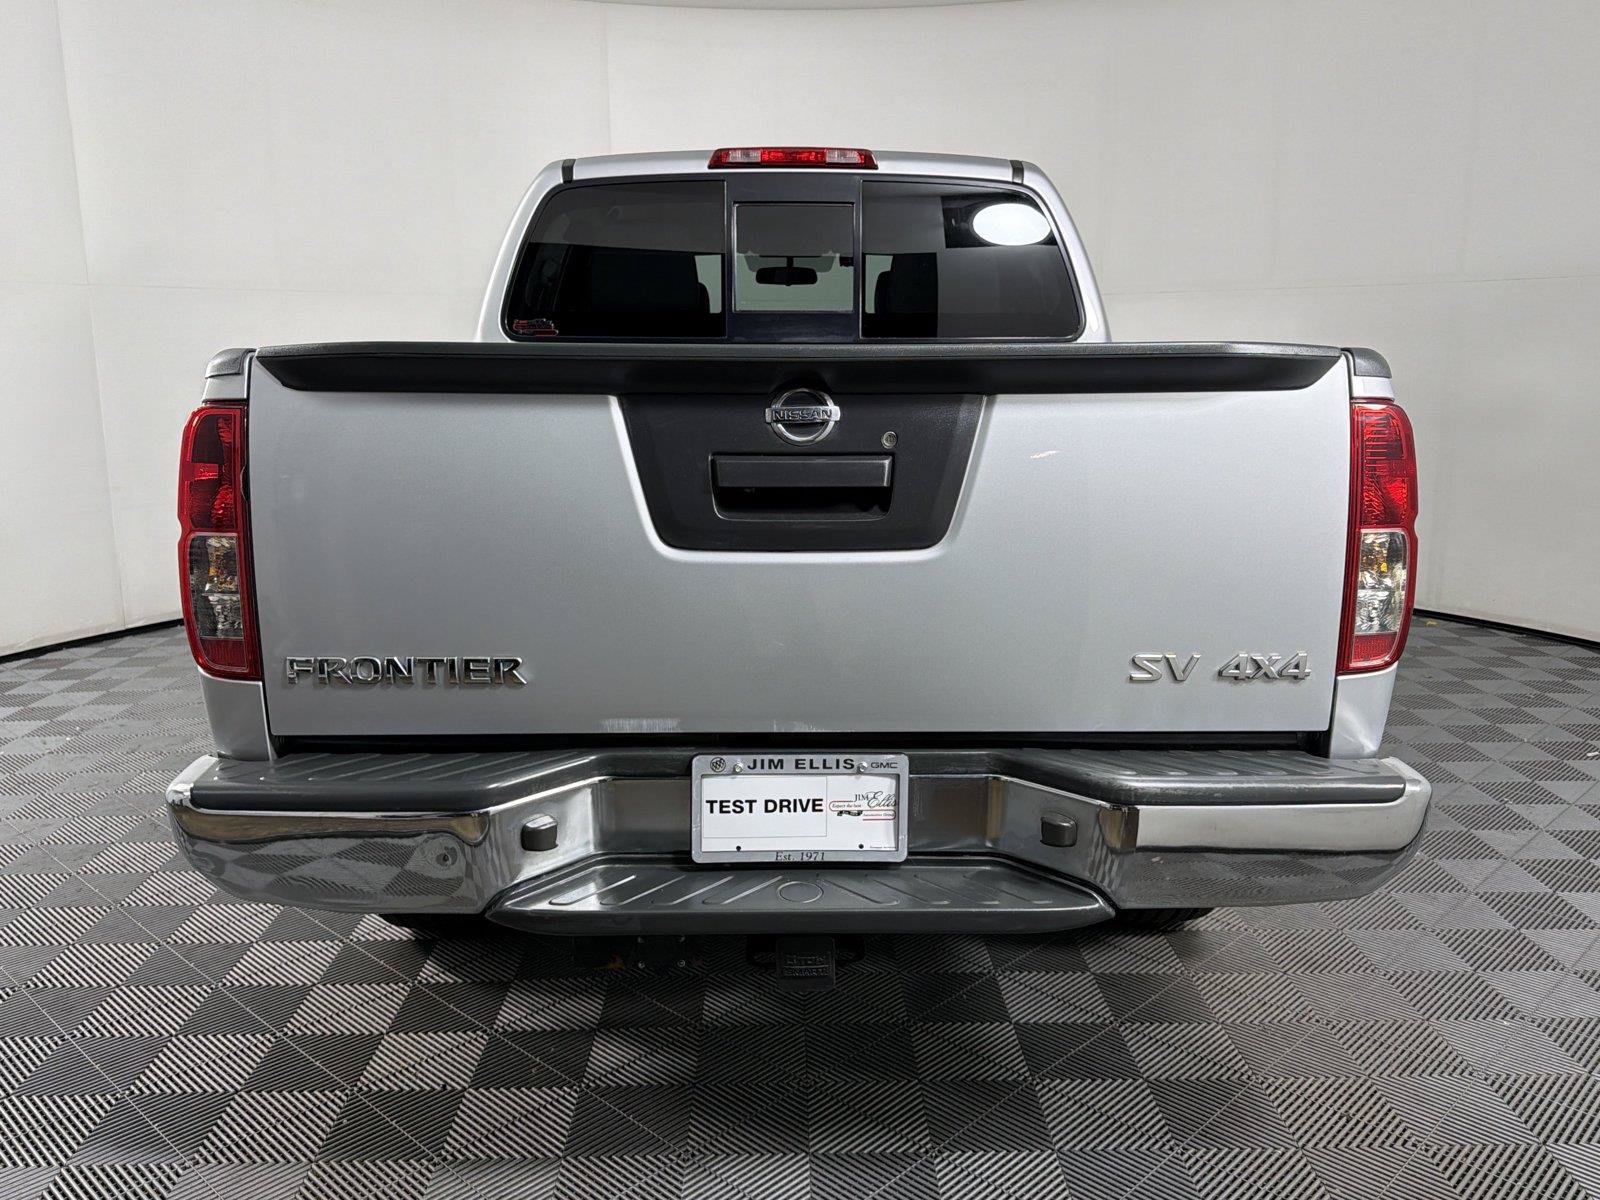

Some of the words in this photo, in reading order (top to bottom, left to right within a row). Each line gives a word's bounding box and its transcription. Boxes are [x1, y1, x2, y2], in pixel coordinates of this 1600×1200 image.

[772, 409, 833, 421] NISSAN
[286, 656, 527, 685] FRONTIER
[1129, 653, 1201, 681] SV
[747, 758, 784, 770] JIM
[795, 758, 855, 770] ELLIS
[705, 799, 758, 814] TEST
[764, 798, 824, 813] DRIVE
[854, 794, 869, 802] JIM
[866, 791, 897, 809] Ellis
[775, 851, 795, 861] Est.
[800, 851, 825, 861] 1971
